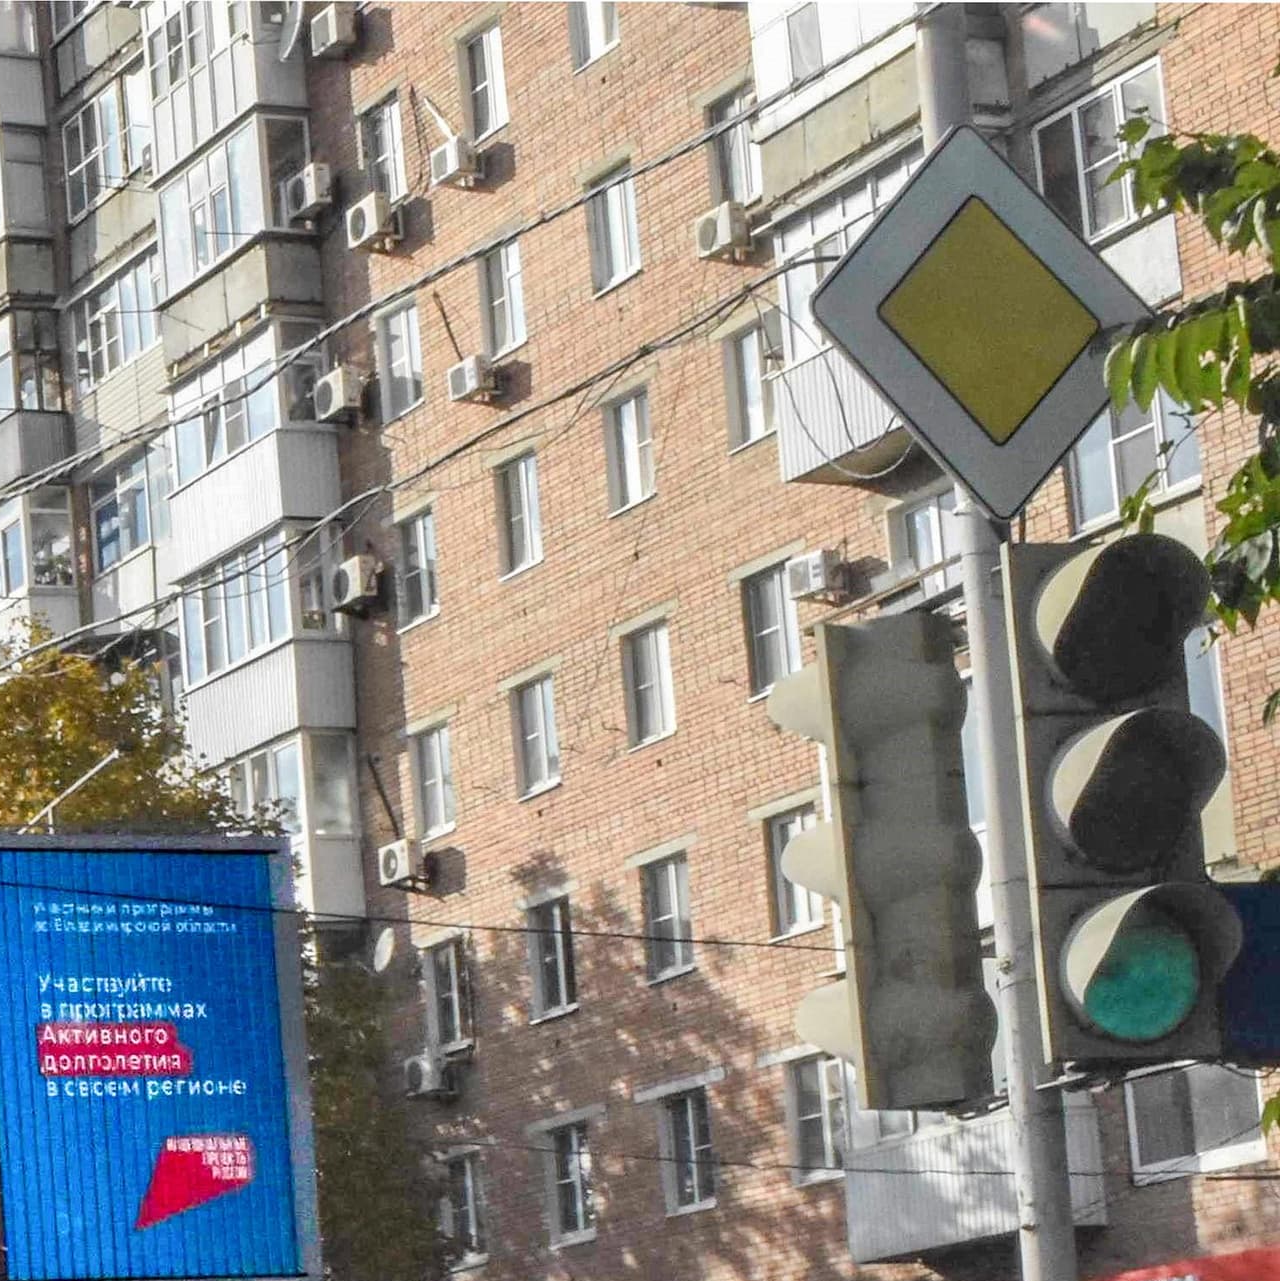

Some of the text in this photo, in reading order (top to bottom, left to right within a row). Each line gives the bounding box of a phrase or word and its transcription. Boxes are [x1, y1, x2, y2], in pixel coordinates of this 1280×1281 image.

[39, 973, 172, 997] Участвуйте
[41, 1002, 207, 1022] в программах
[41, 1024, 168, 1045] Активного
[40, 1054, 181, 1074] долголетия
[47, 1079, 247, 1100] в своем регионе
